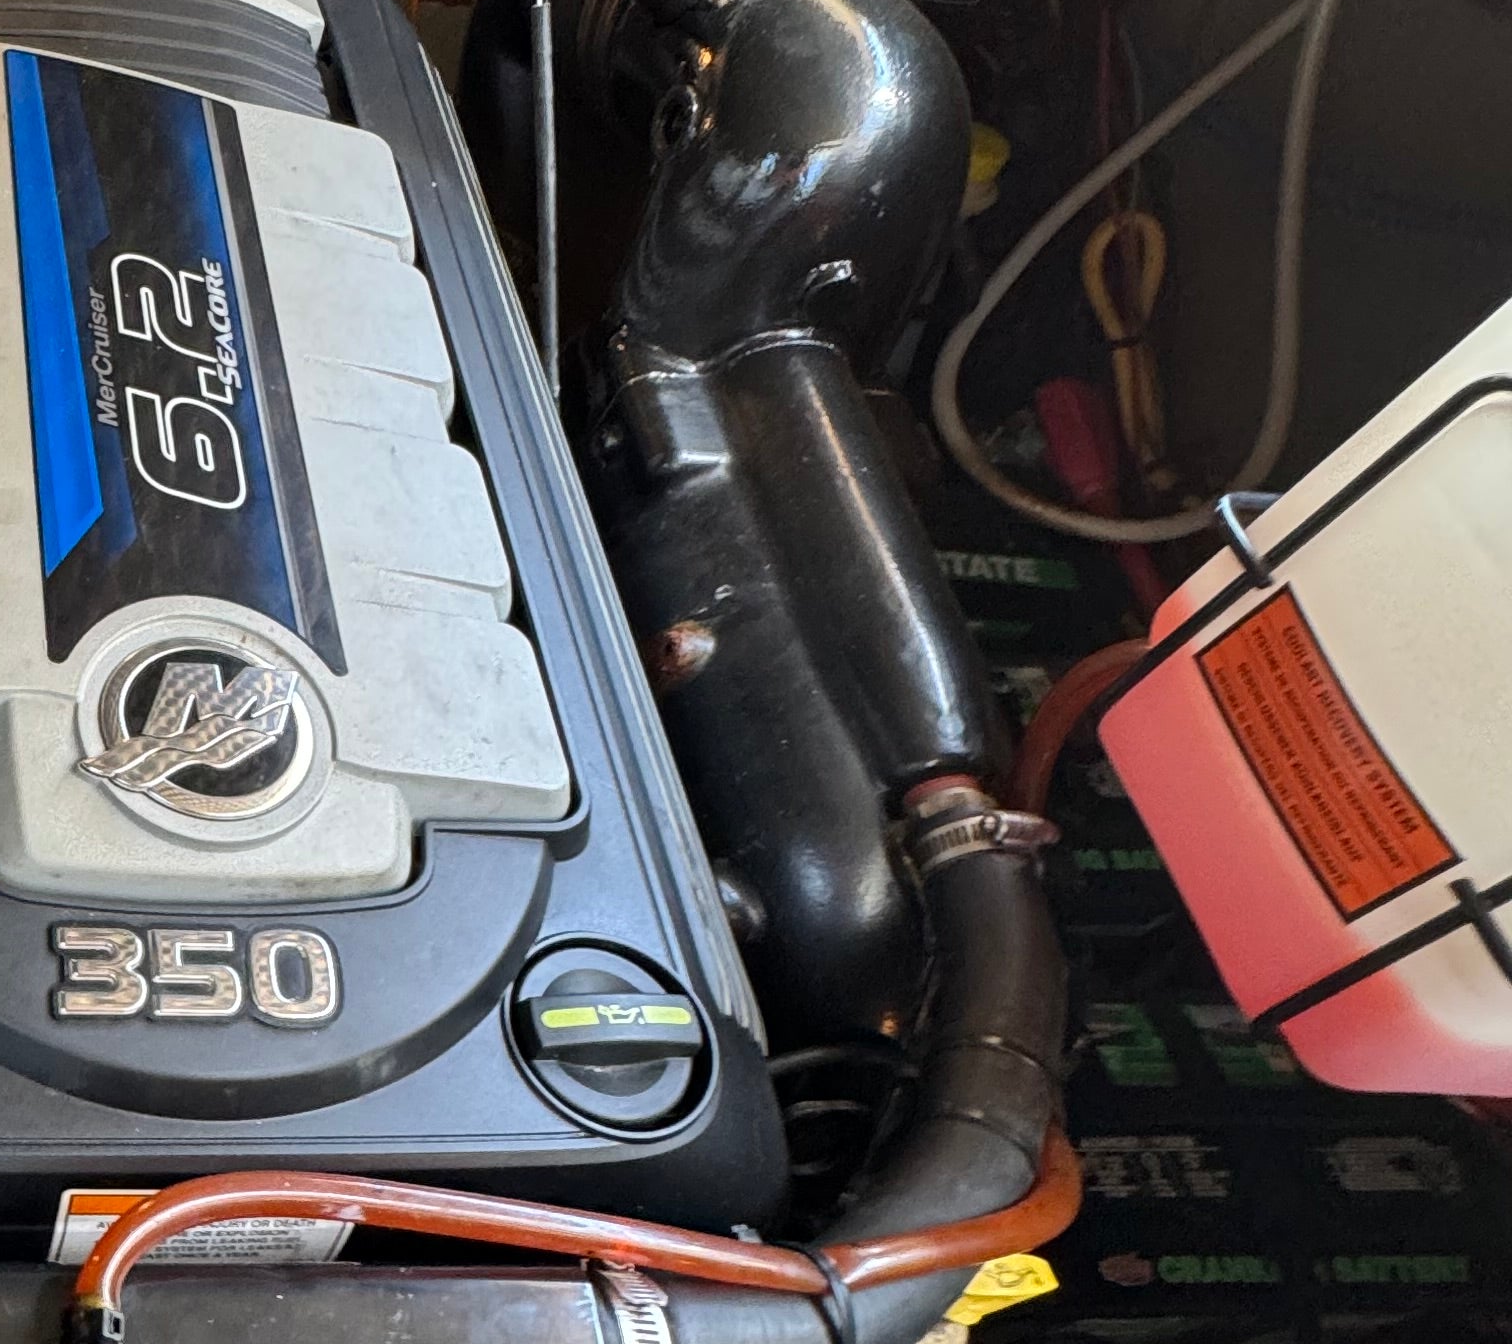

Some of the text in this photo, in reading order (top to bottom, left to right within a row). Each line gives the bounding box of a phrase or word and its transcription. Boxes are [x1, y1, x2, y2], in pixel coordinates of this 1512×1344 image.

[89, 287, 119, 427] MerCruiser
[201, 257, 243, 389] SEACORE
[51, 922, 343, 1024] 350
